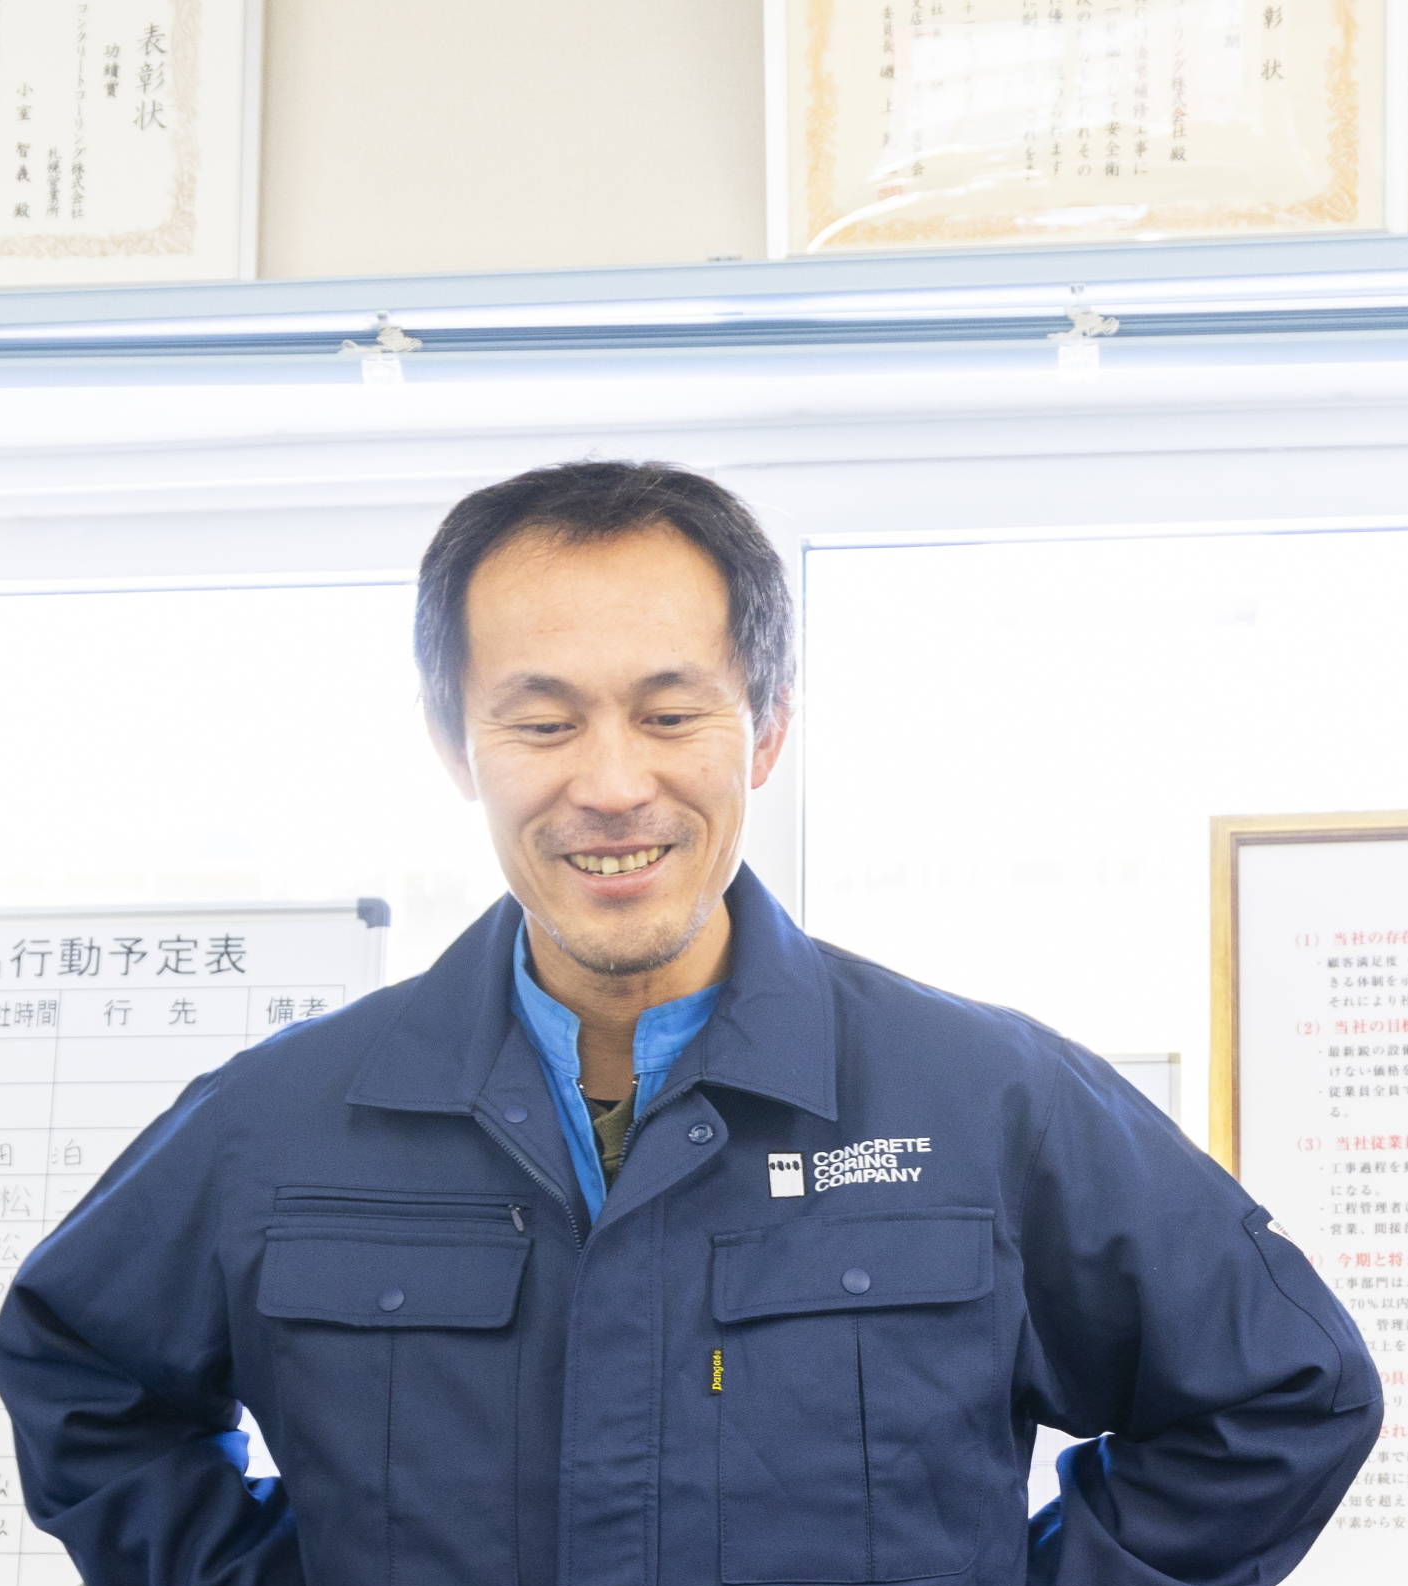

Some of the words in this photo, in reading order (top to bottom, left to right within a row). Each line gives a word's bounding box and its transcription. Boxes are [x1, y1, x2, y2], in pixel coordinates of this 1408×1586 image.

[133, 22, 168, 130] 表彰状
[10, 934, 248, 978] 行動予定表
[813, 1138, 932, 1165] CONCRETE
[814, 1154, 897, 1180] CORING
[815, 1167, 921, 1192] COMPANY
